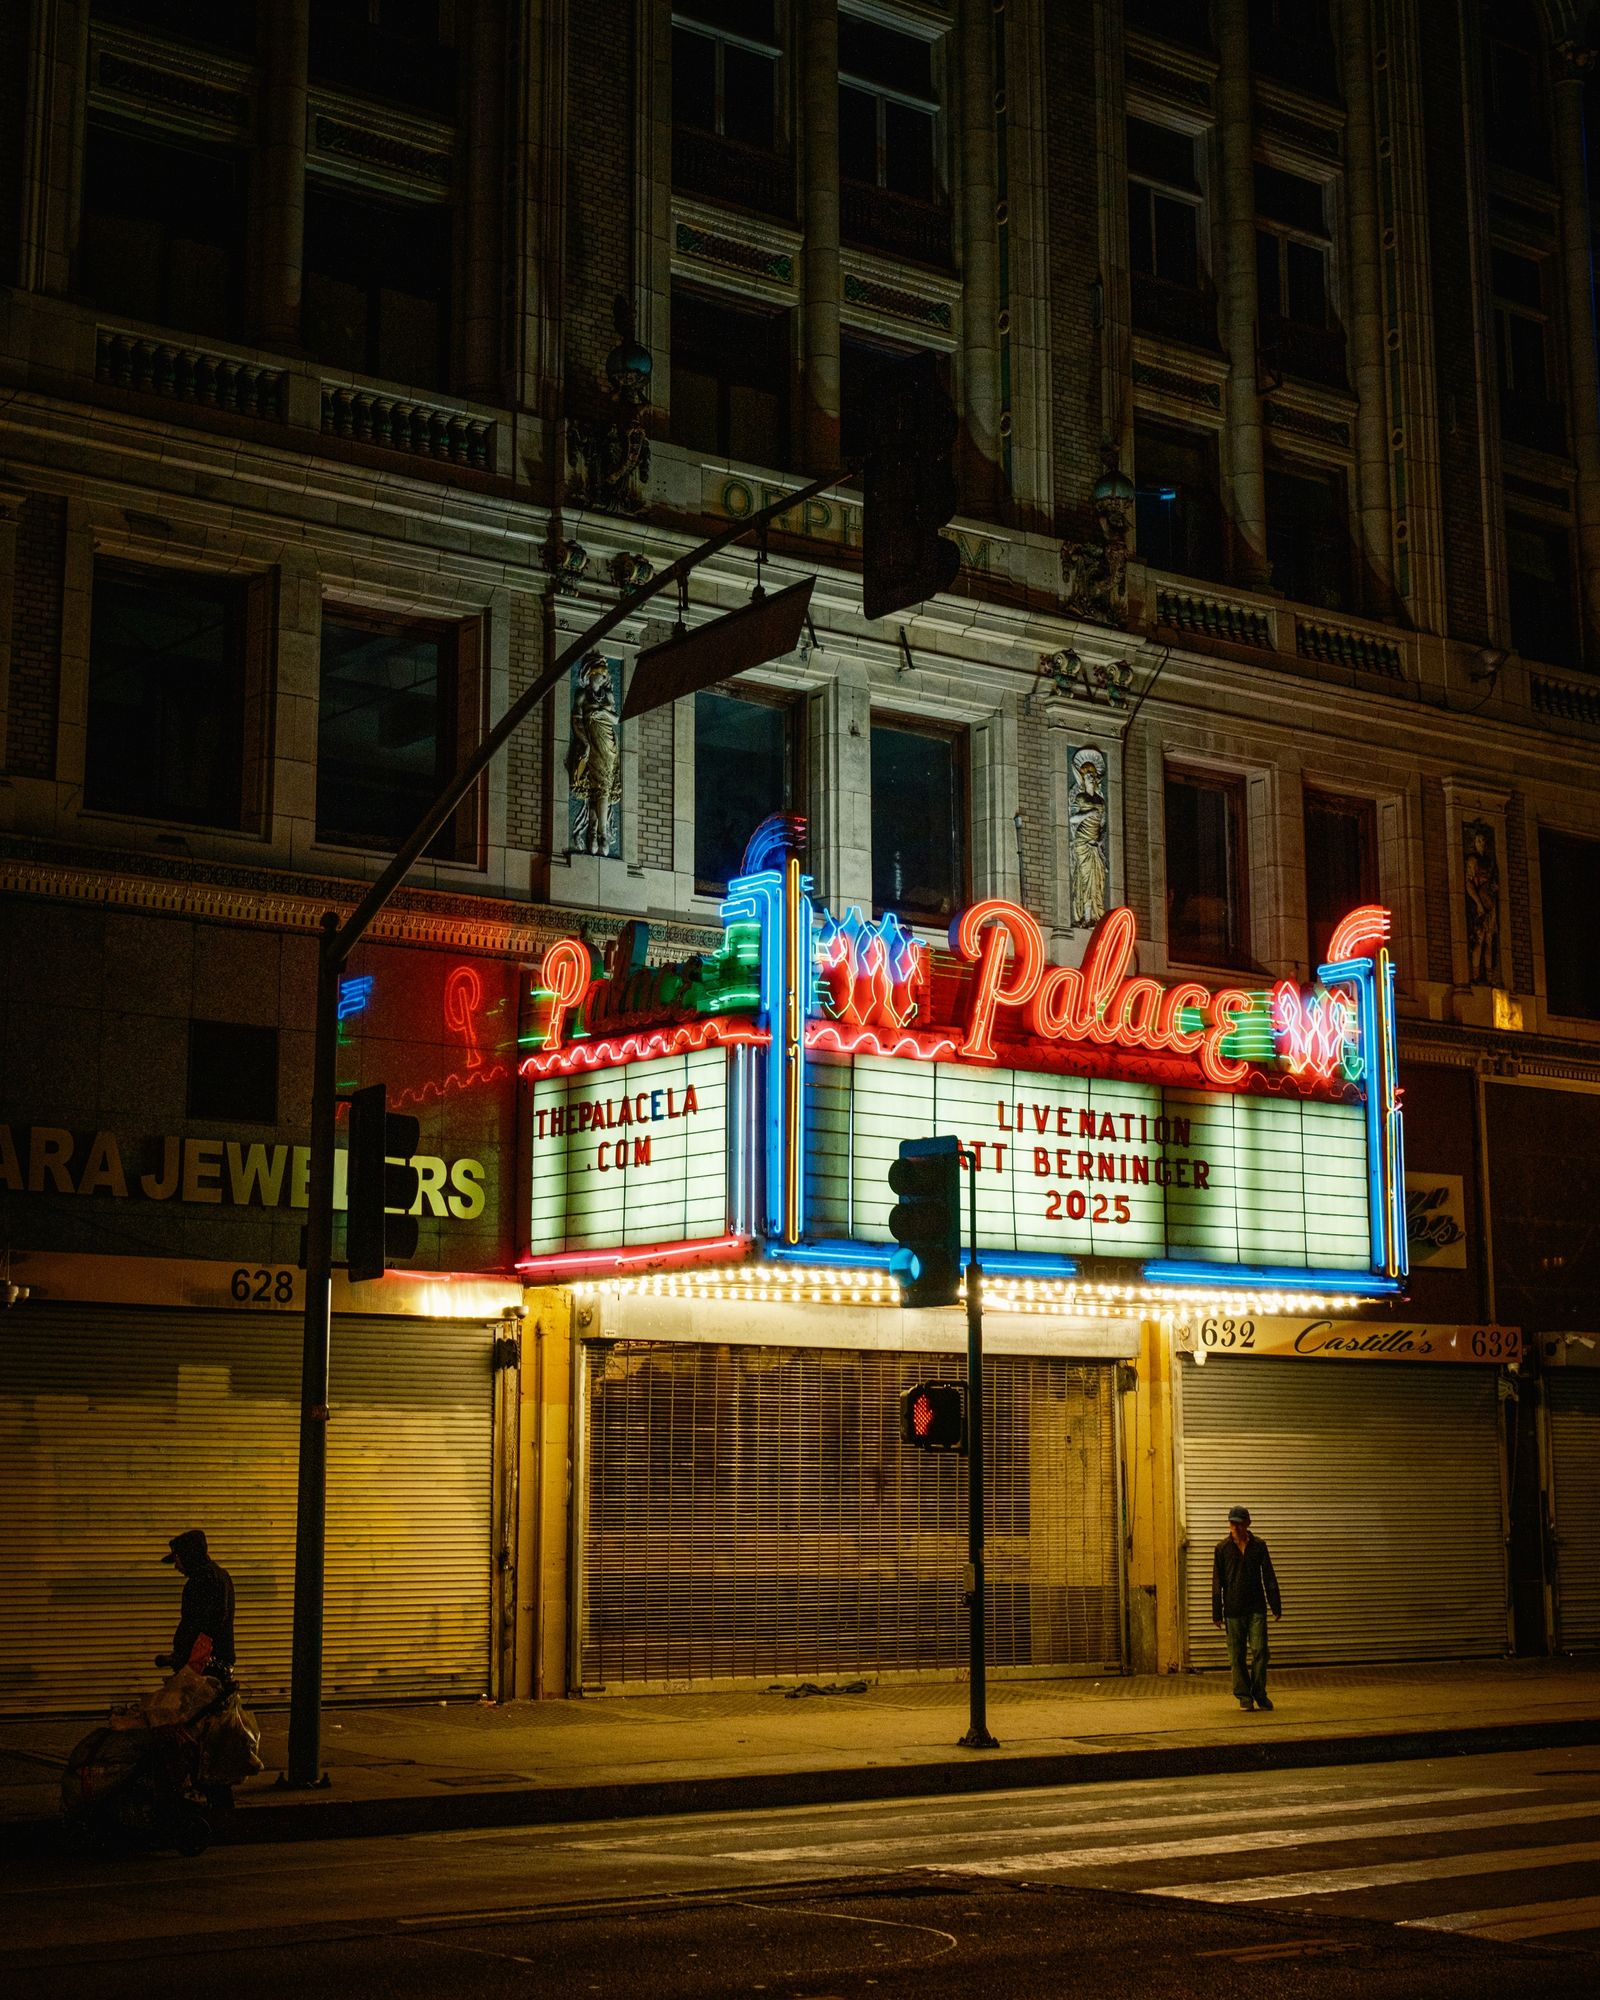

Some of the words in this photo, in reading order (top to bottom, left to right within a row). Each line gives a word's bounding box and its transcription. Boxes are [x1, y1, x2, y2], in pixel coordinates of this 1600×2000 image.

[959, 899, 1255, 1085] Palace
[535, 1084, 698, 1140] THEPALACELA
[998, 1100, 1191, 1148] LIVENATION
[587, 1135, 652, 1173] .COM
[1033, 1146, 1210, 1190] BERNINGER
[1046, 1190, 1131, 1224] 2025
[230, 1269, 293, 1304] 628
[1201, 1318, 1256, 1349] 632
[1294, 1320, 1435, 1354] Castillo's
[1471, 1330, 1519, 1358] 632
